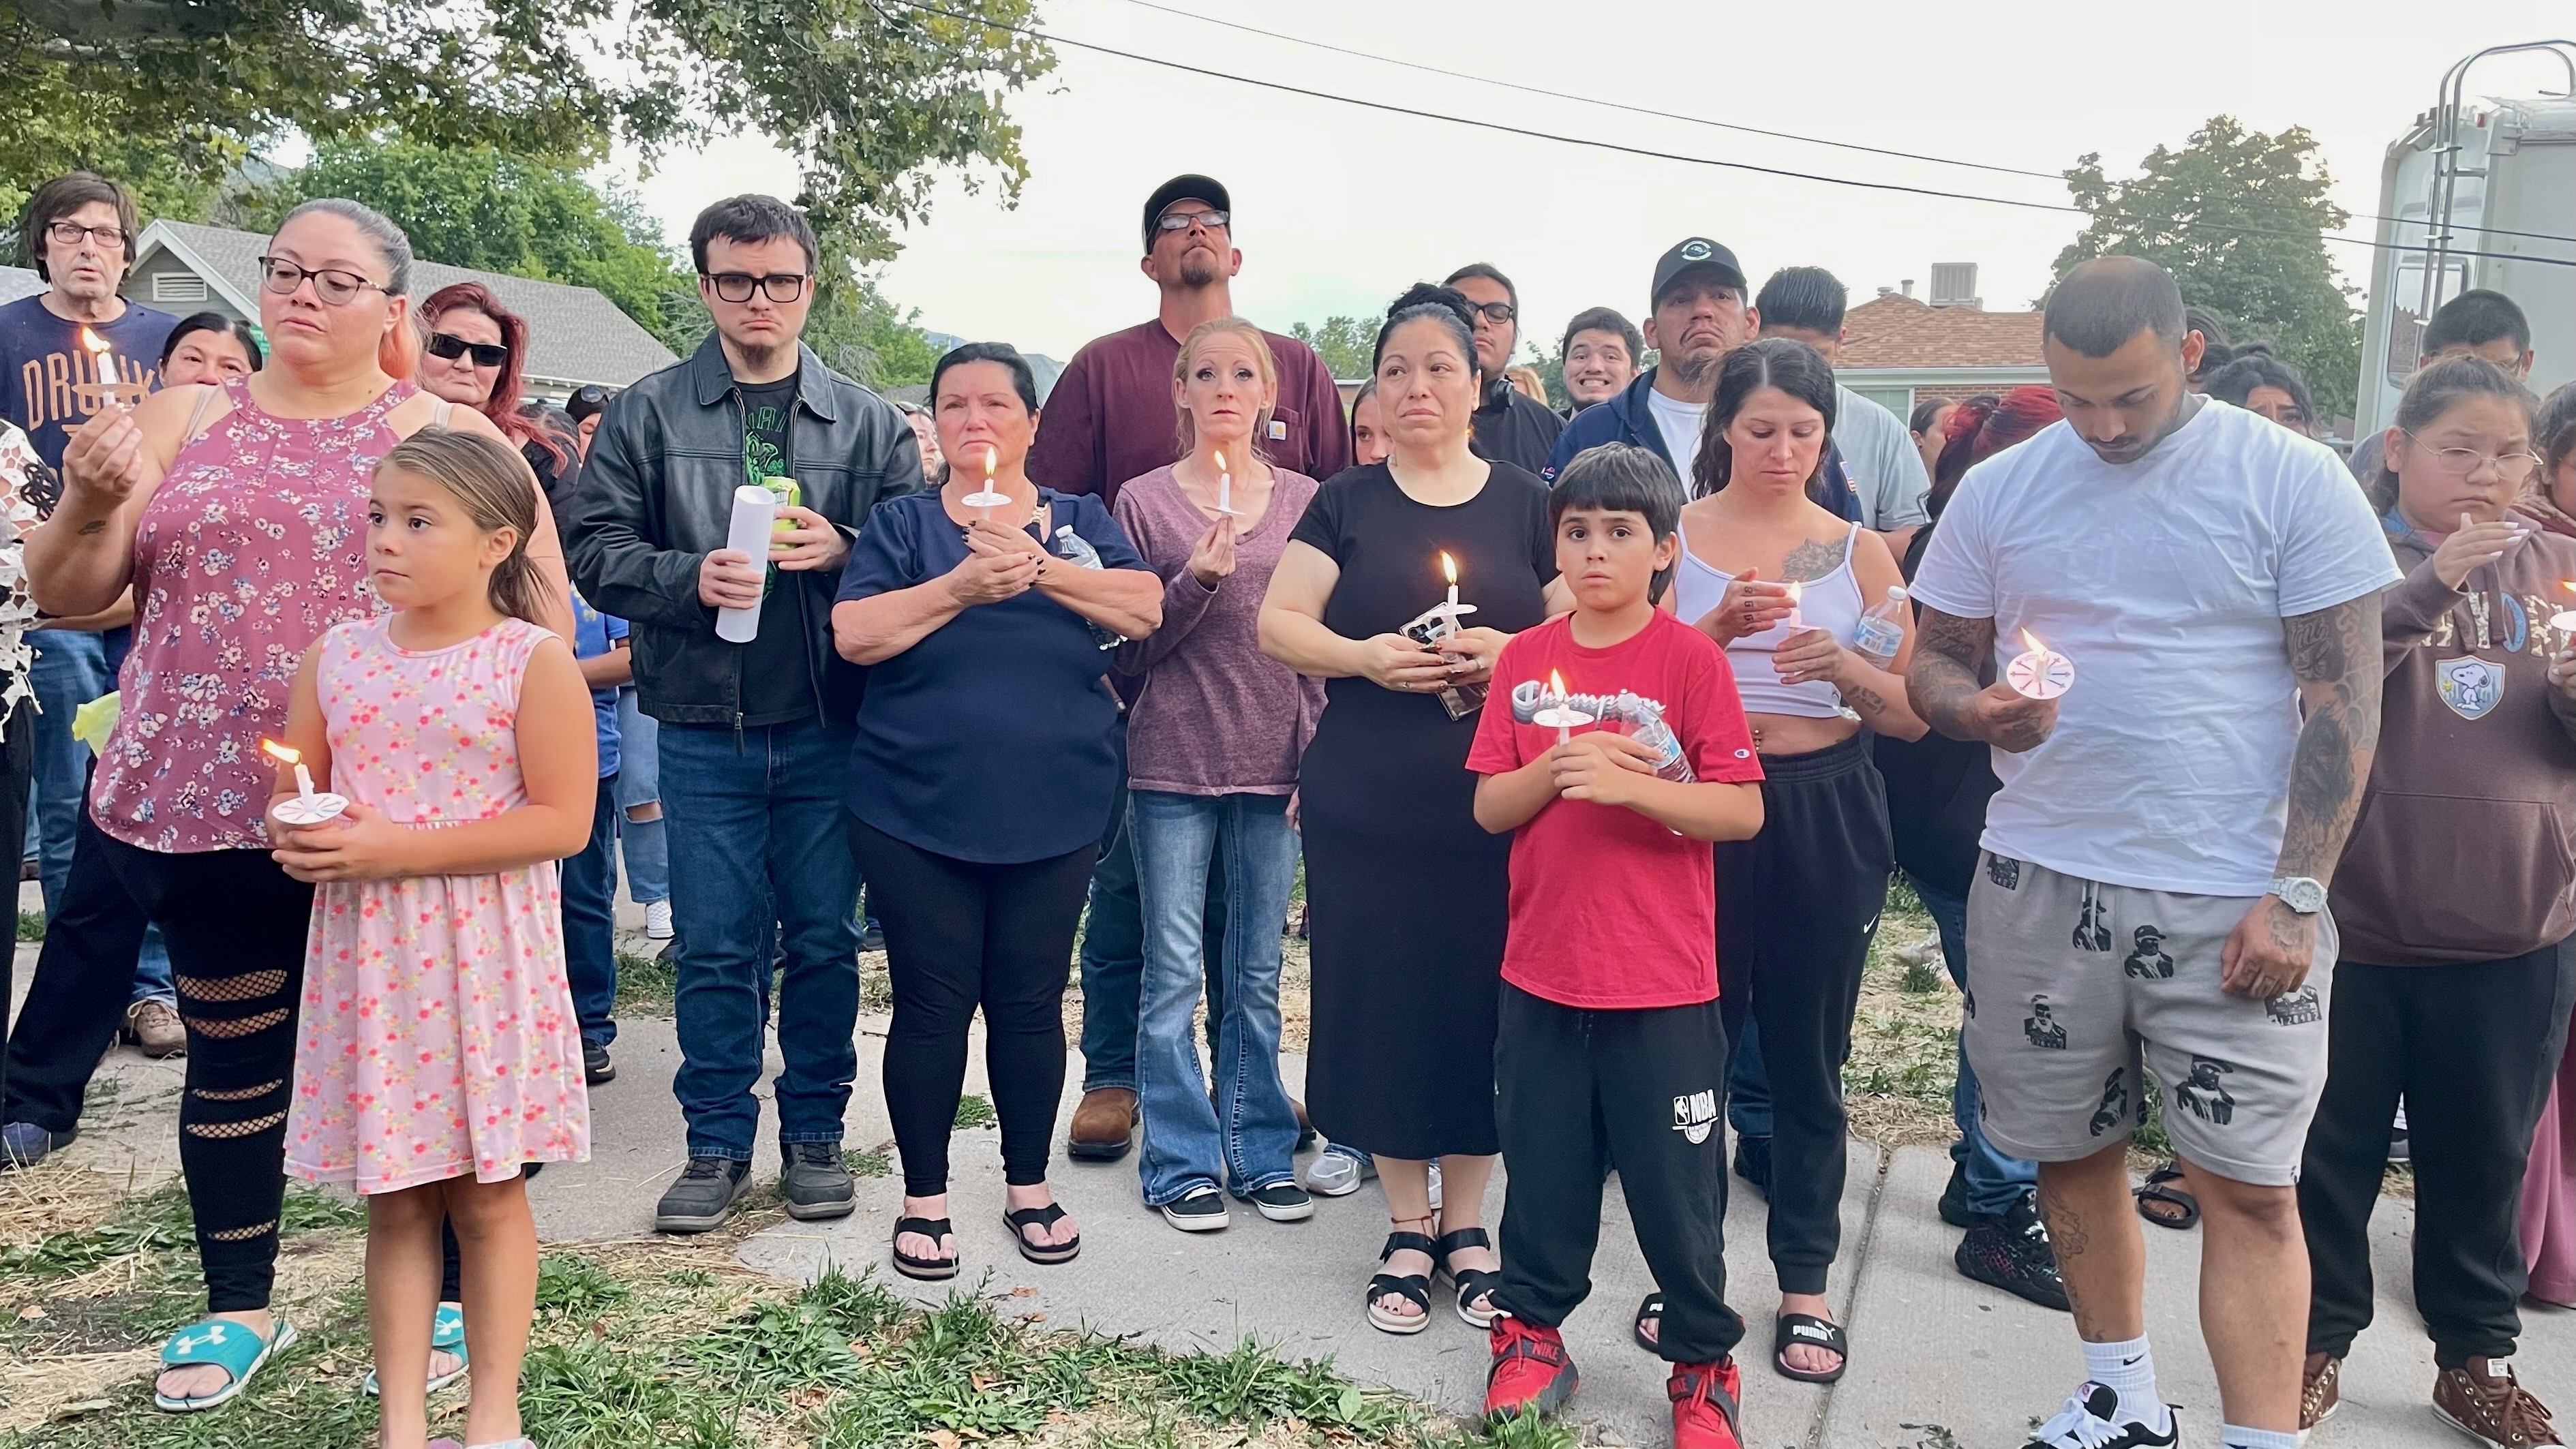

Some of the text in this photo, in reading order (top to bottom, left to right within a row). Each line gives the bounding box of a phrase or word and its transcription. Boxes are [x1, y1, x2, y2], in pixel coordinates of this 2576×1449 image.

[1512, 680, 1667, 727] Chmpn
[1690, 1089, 1717, 1124] NBA
[1532, 1341, 1560, 1361] NIKE
